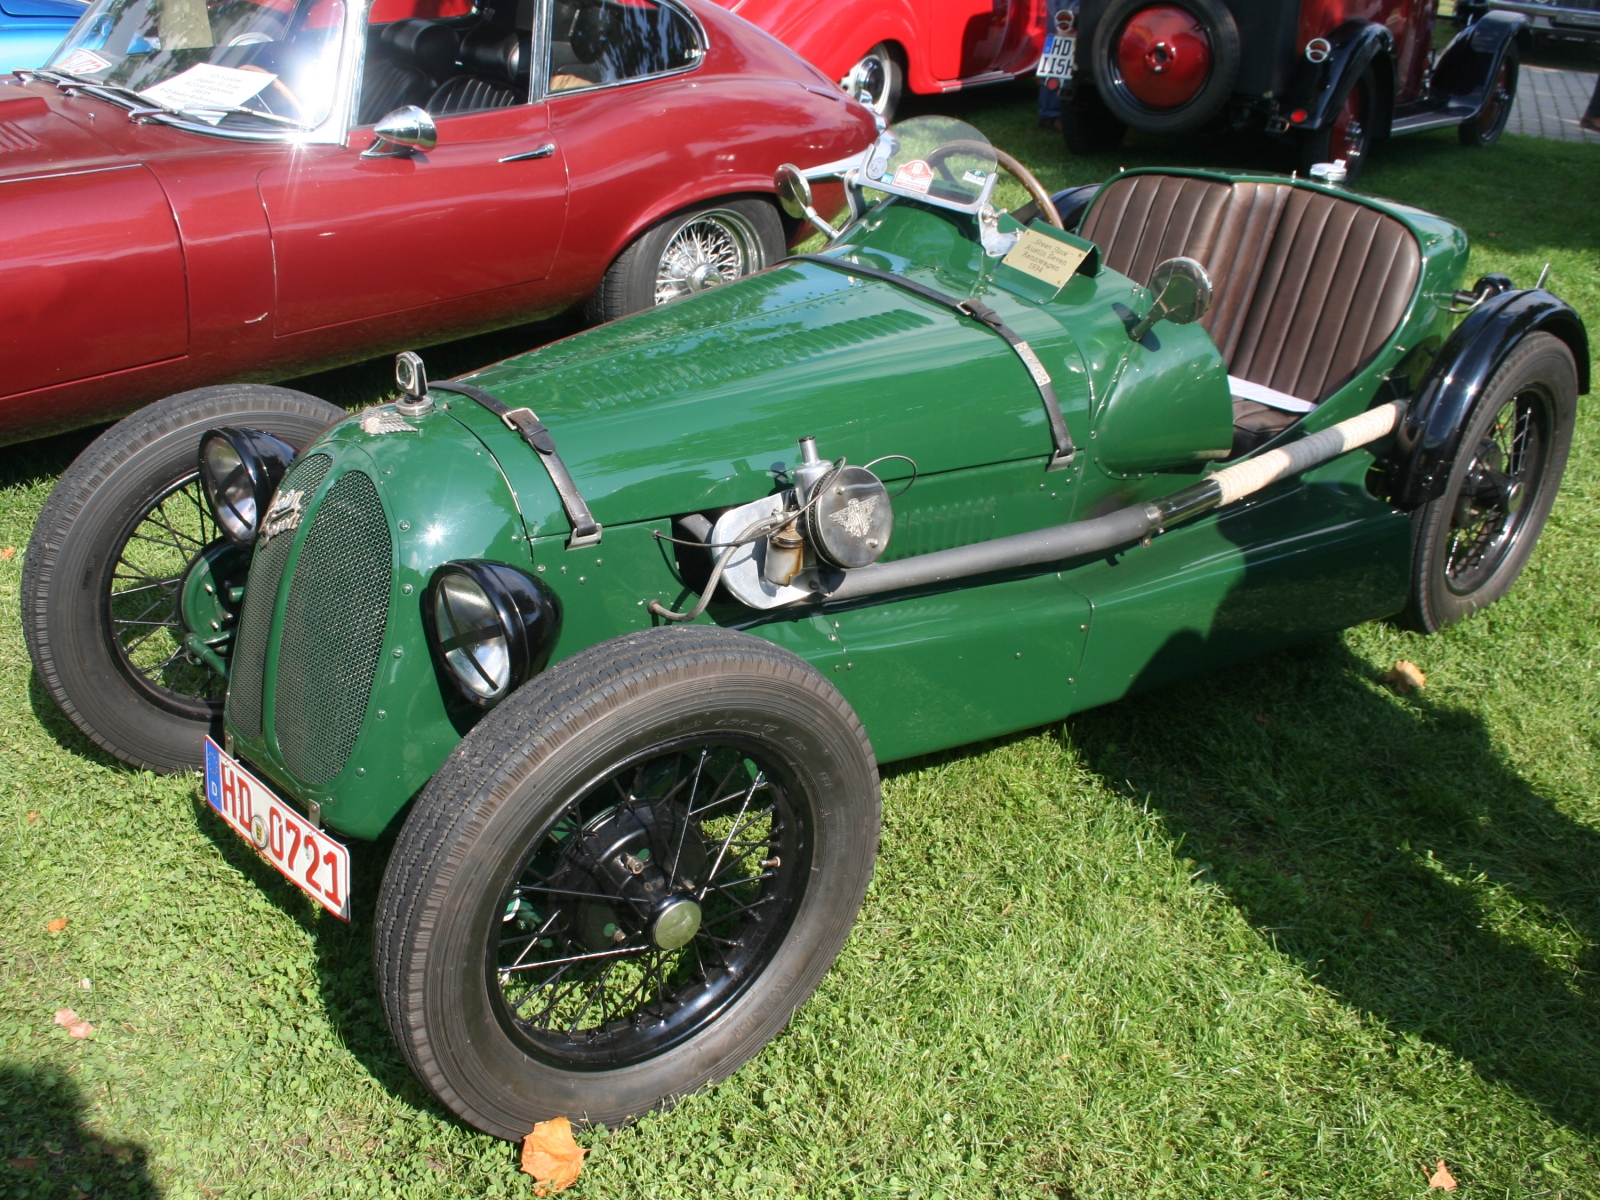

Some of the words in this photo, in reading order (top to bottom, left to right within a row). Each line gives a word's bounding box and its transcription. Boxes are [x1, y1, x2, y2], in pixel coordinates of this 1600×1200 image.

[1051, 38, 1072, 56] HD
[1021, 251, 1060, 272] Rennwagen
[1024, 244, 1048, 258] Austin
[1047, 252, 1068, 266] Seven
[1027, 262, 1044, 273] 1934
[211, 781, 217, 797] D
[221, 762, 254, 833] HD
[269, 806, 343, 908] 0721
